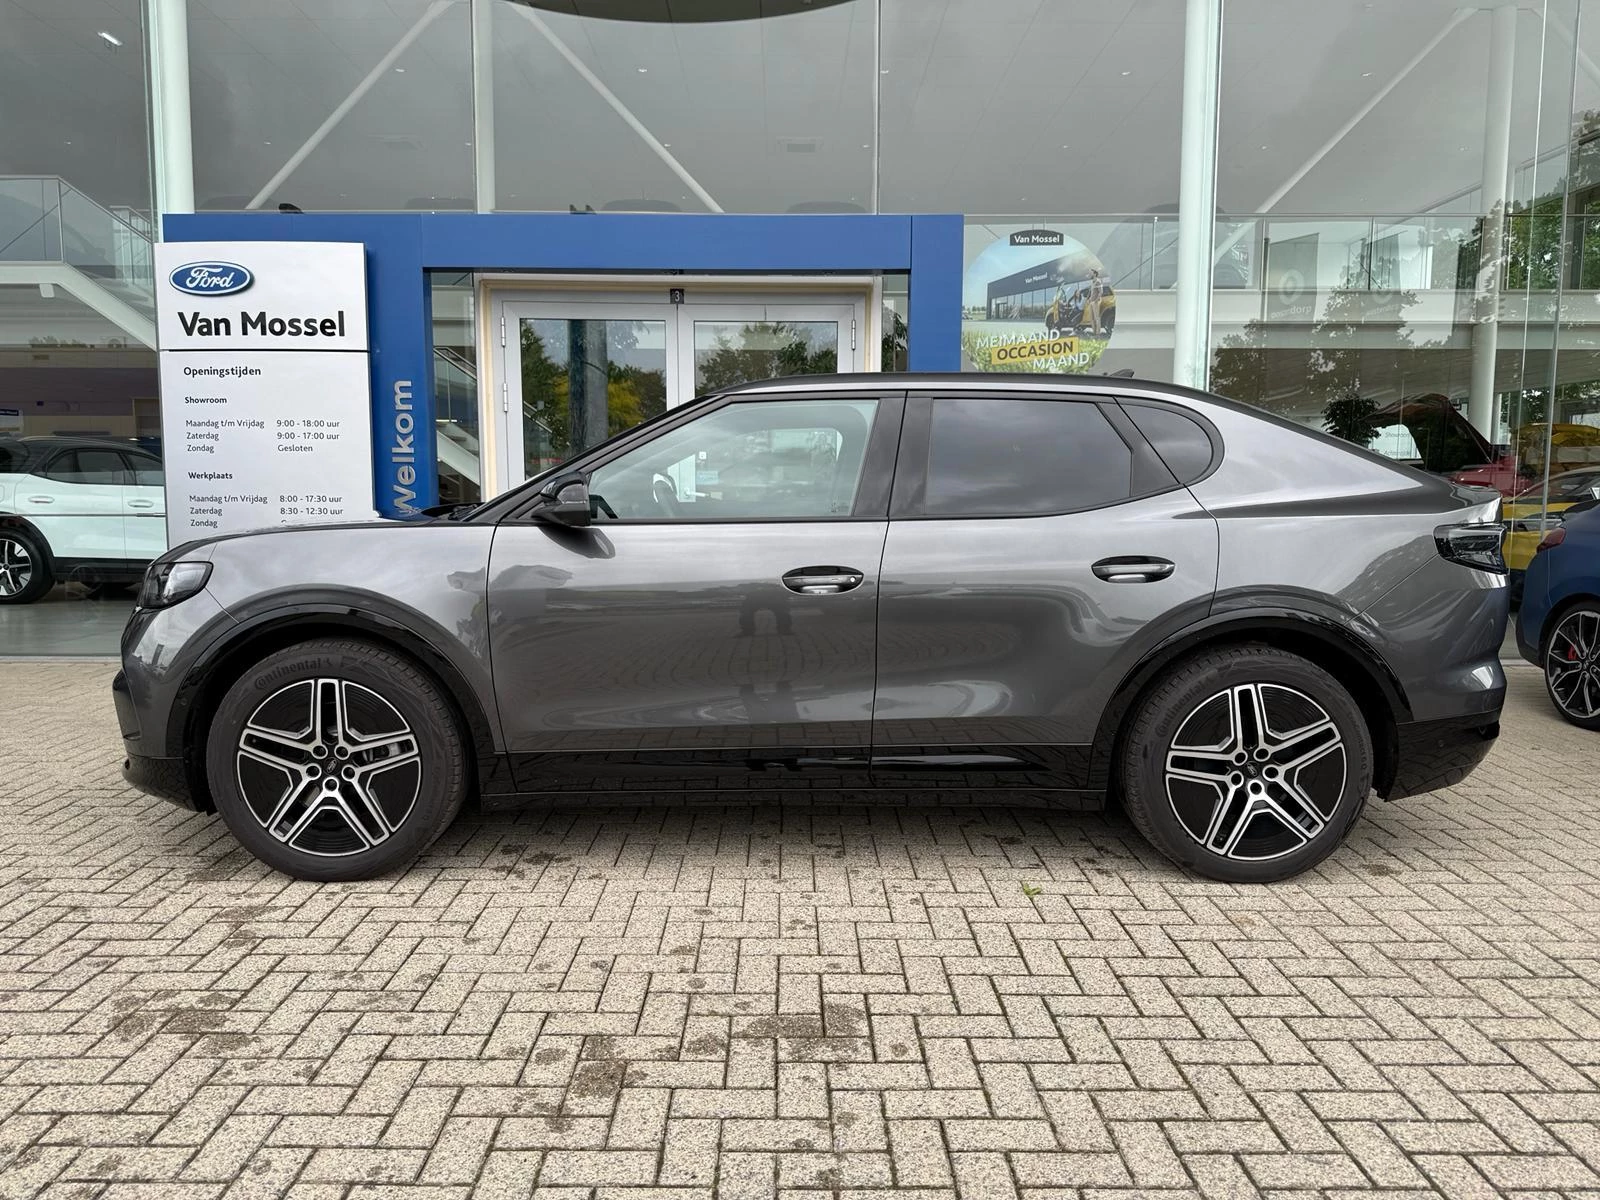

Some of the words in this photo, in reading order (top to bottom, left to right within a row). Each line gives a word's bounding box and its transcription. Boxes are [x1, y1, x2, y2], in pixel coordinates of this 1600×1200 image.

[1014, 235, 1029, 243] Van
[1031, 234, 1060, 243] Mossel
[185, 267, 234, 288] Ford
[675, 290, 680, 302] 3
[177, 311, 231, 337] Van
[241, 310, 345, 337] Mossel
[976, 329, 1060, 349] MEIMAAND
[997, 341, 1074, 361] OCCASION
[1033, 352, 1090, 370] MAAND
[183, 366, 261, 378] Openingstijden
[184, 396, 227, 404] Showroom
[185, 420, 220, 429] Maandag
[221, 420, 236, 428] t/m
[237, 419, 265, 429] Vrijdag
[276, 420, 295, 428] 9:00
[302, 419, 325, 428] 18:00
[186, 432, 219, 441] Zaterdag
[277, 432, 295, 440] 9:00
[302, 432, 325, 440] 17:00
[187, 444, 214, 454] Zondag
[277, 444, 313, 452] Gesloten
[392, 379, 416, 515] Welkom
[188, 472, 233, 481] Werkplaats
[189, 495, 222, 504] Maandag
[224, 495, 239, 503] t/m
[239, 495, 268, 504] Vrijdag
[279, 495, 298, 503] 8:00
[305, 495, 328, 503] 17:30
[189, 507, 222, 516] Zaterdag
[280, 507, 299, 515] 8:30
[306, 507, 329, 515] 12:30
[190, 519, 218, 528] Zondag
[254, 657, 321, 690] Continental
